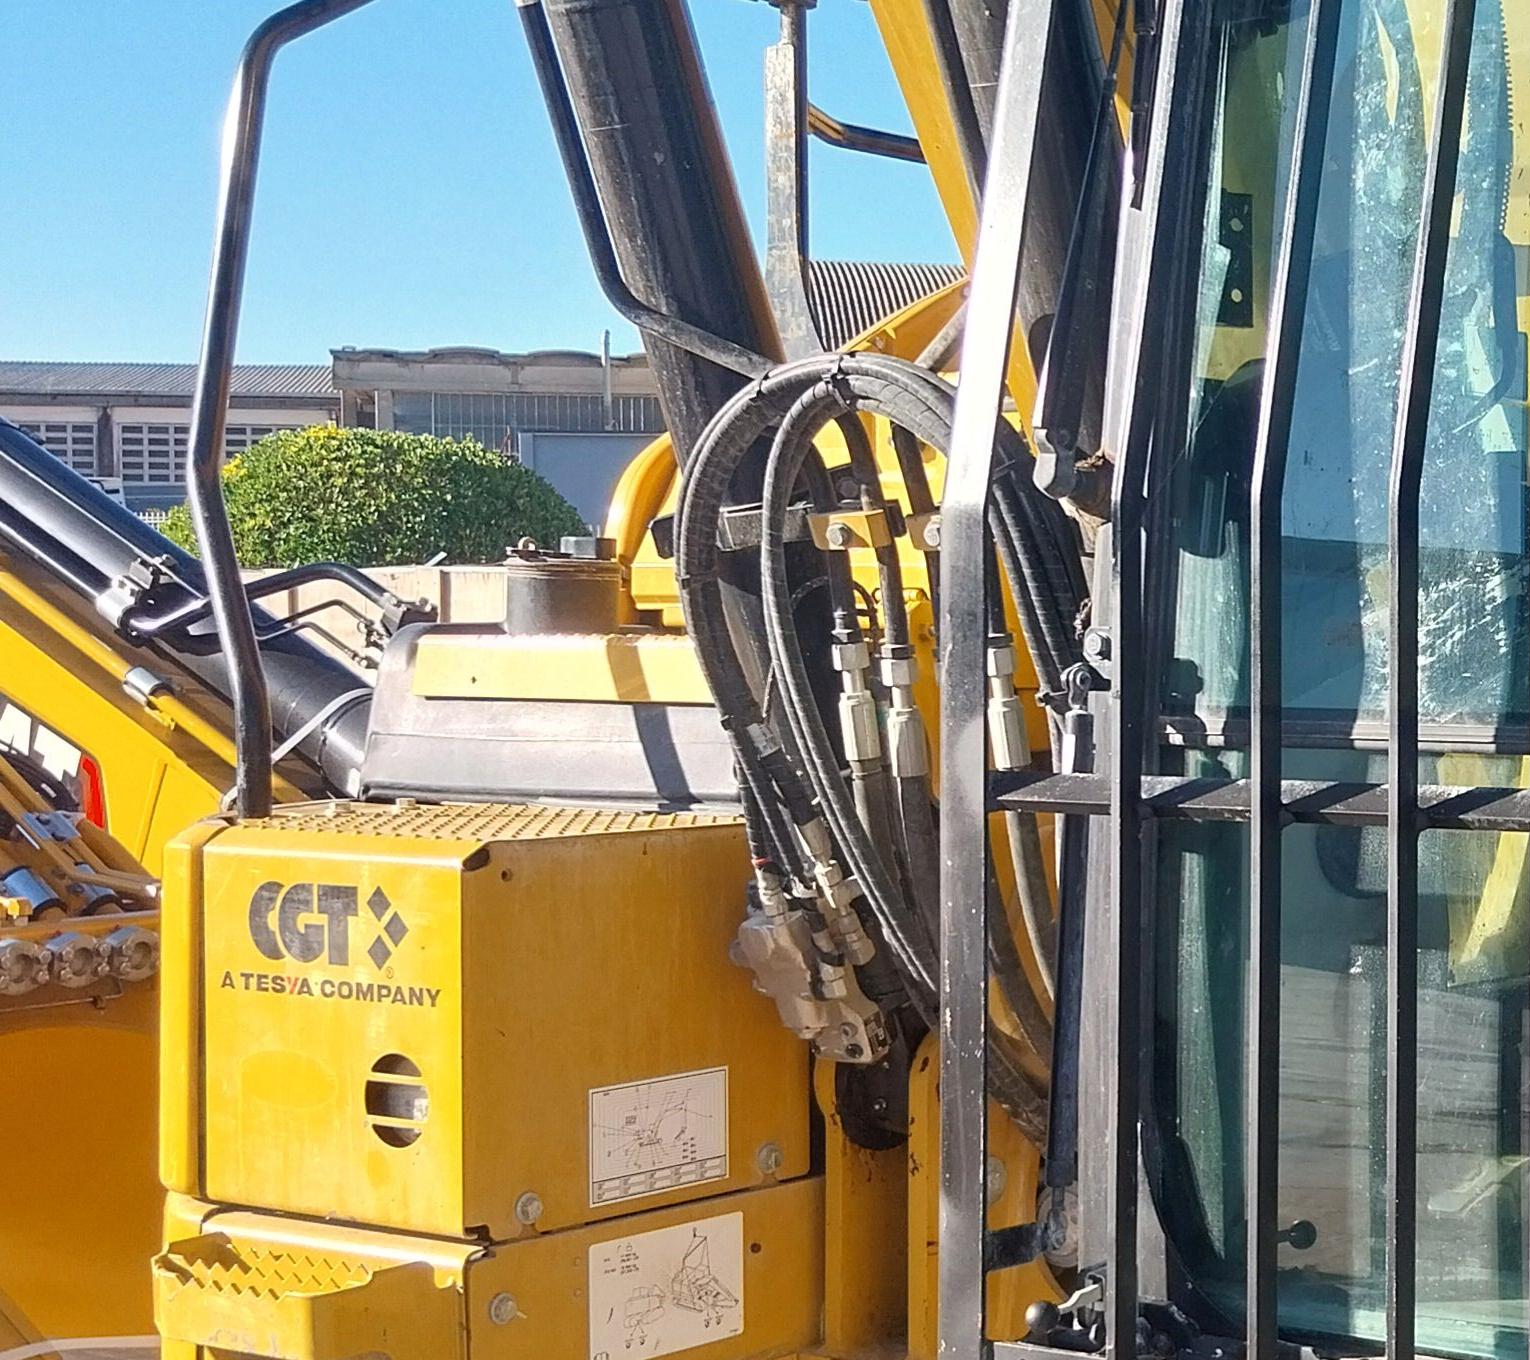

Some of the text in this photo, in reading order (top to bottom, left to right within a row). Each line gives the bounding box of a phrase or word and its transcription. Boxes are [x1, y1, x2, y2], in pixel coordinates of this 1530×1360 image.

[248, 880, 359, 967] CGT
[220, 970, 442, 1008] A TESYA COMPANY
